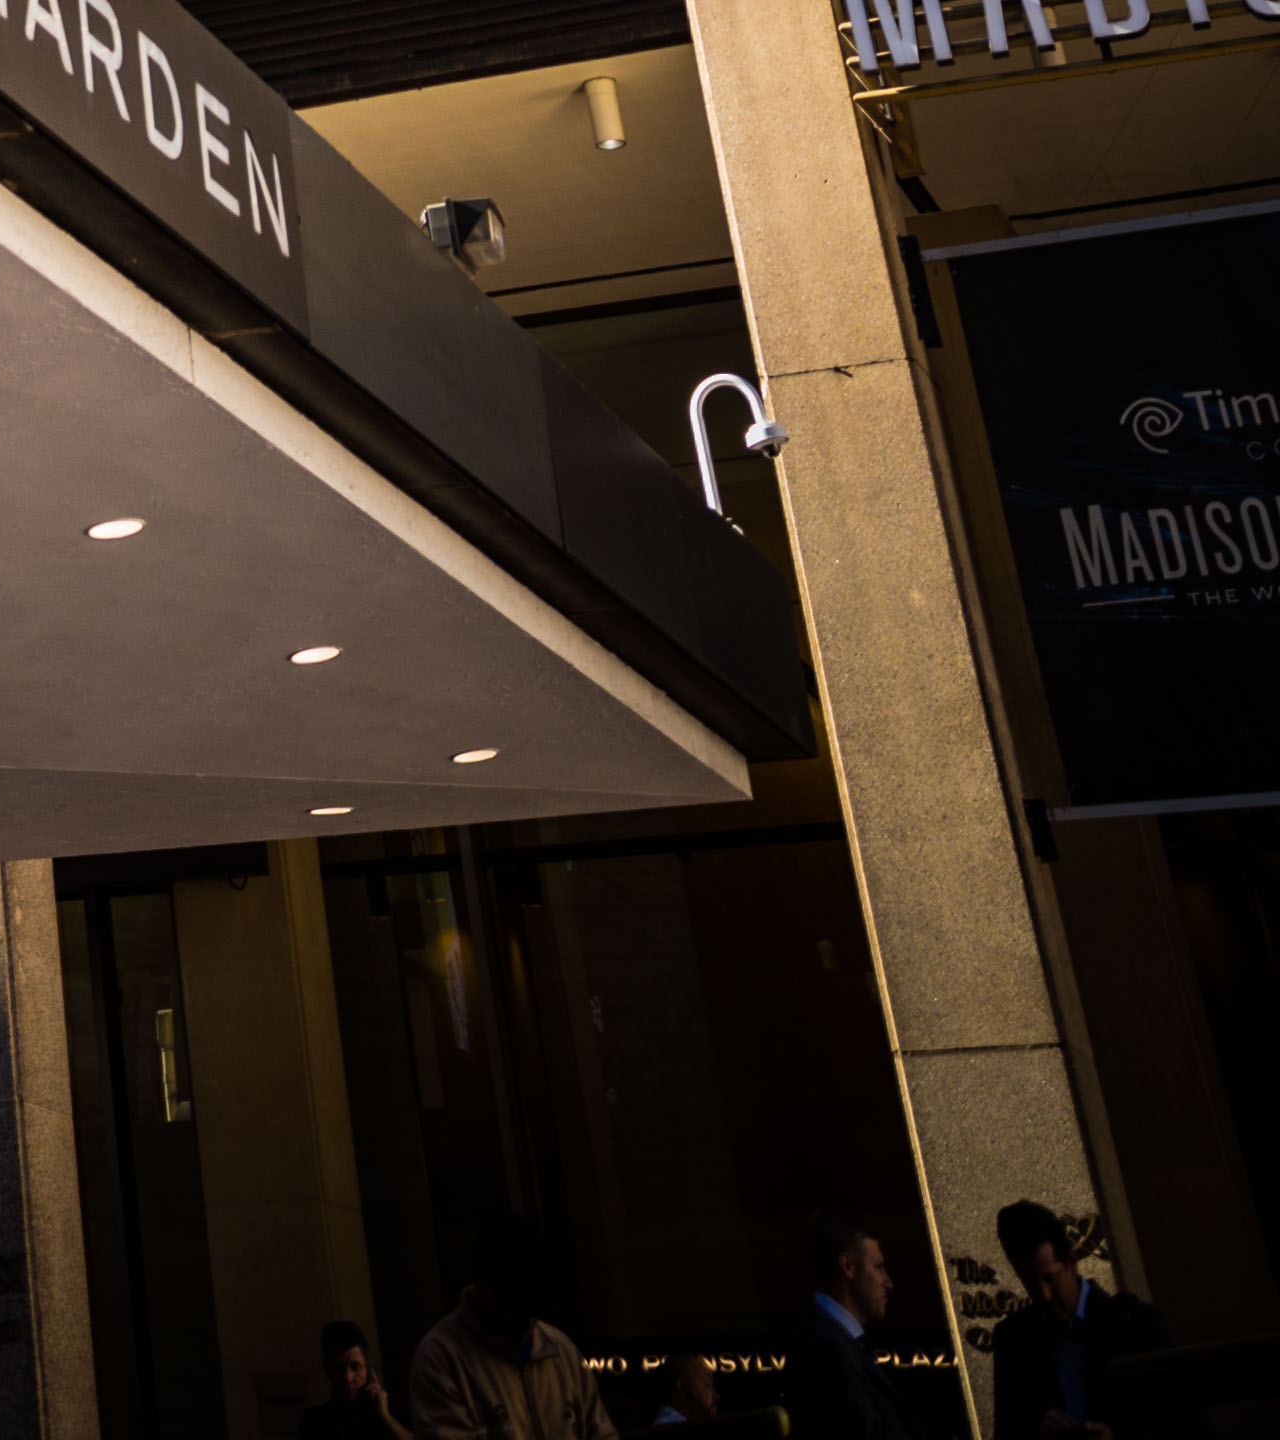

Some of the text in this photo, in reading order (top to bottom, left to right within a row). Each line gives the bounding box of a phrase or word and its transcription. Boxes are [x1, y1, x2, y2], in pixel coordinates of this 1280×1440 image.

[1058, 494, 1280, 591] MADISO
[1186, 587, 1241, 609] THE
[581, 1353, 628, 1376] WO
